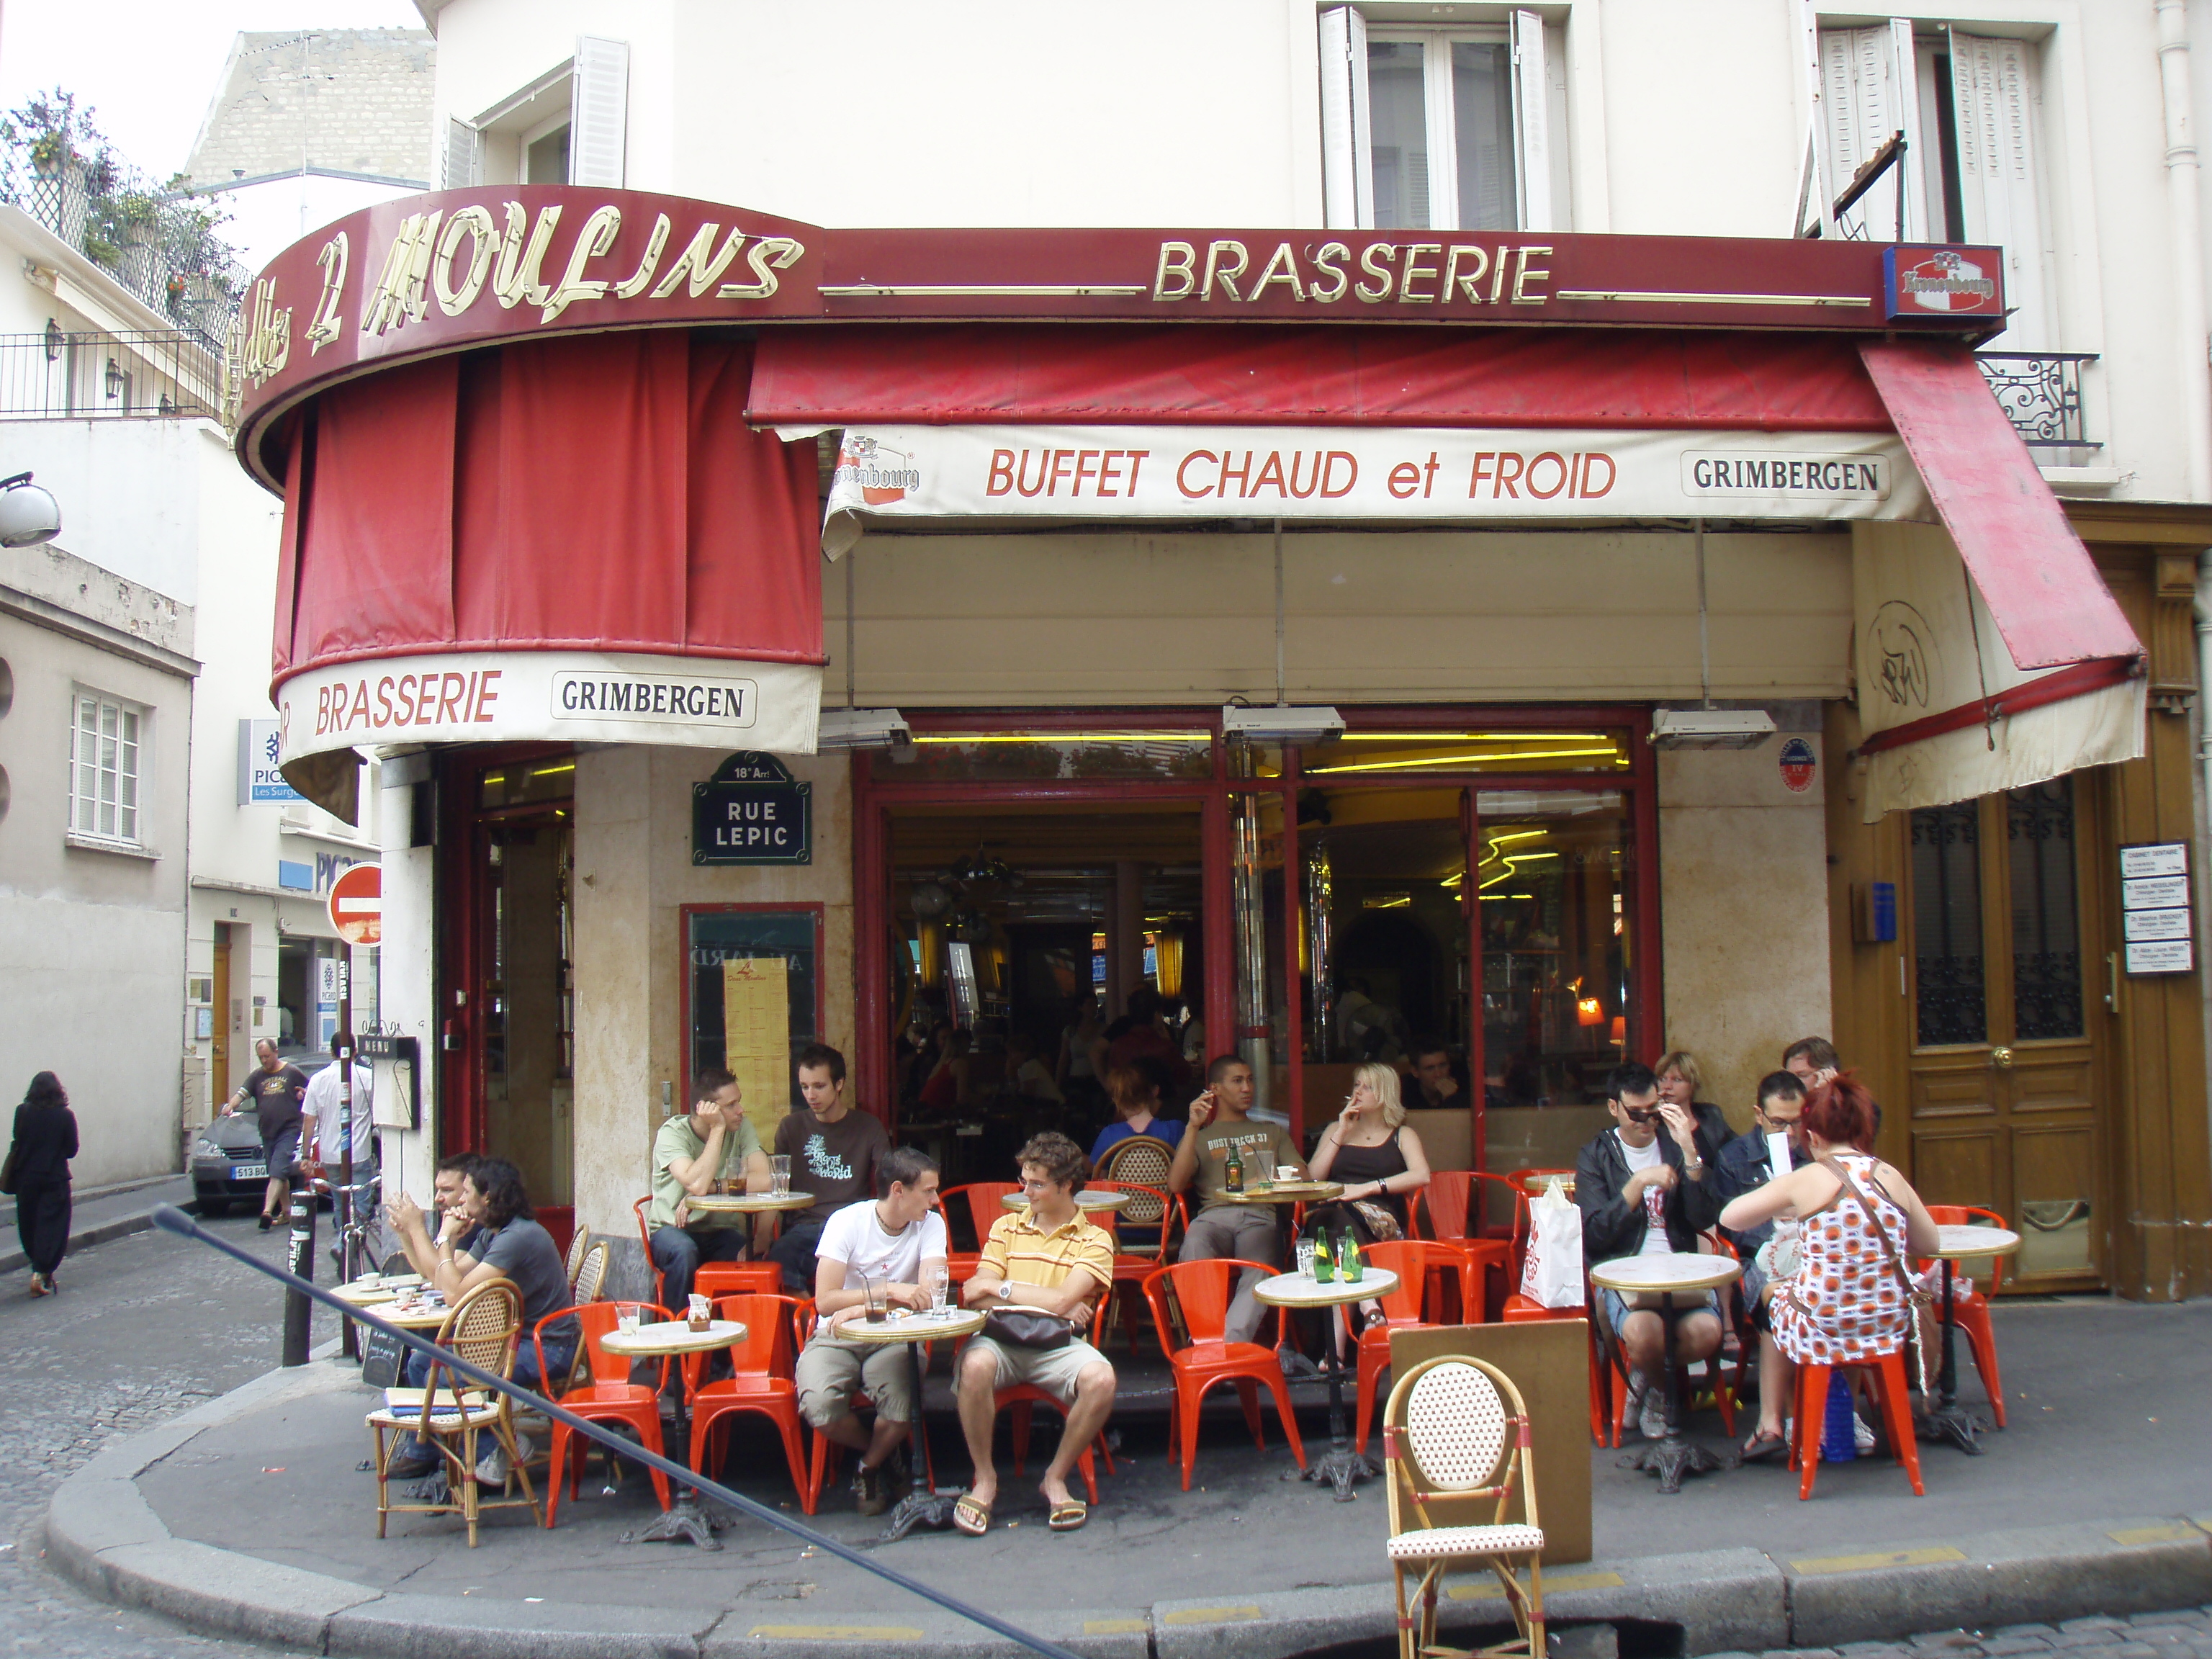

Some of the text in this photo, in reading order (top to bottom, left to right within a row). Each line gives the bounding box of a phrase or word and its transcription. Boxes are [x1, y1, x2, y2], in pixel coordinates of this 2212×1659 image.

[305, 230, 349, 356] 2
[361, 201, 806, 338] MOULINS
[1152, 240, 1554, 306] BRASSERIE
[1902, 271, 1994, 300] Kronenbourg
[835, 463, 920, 492] onenbourg
[986, 449, 1617, 500] BUFFET CHAUD et FROID
[1694, 459, 1879, 491] GRIMBERGEN
[315, 670, 502, 735] BRASSERIE
[562, 681, 745, 718] GRIMBERGEN
[256, 787, 269, 796] Les
[728, 802, 776, 820] RUE
[716, 827, 787, 845] LEPIC
[365, 1040, 389, 1053] MENU
[1208, 1138, 1228, 1151] DUST
